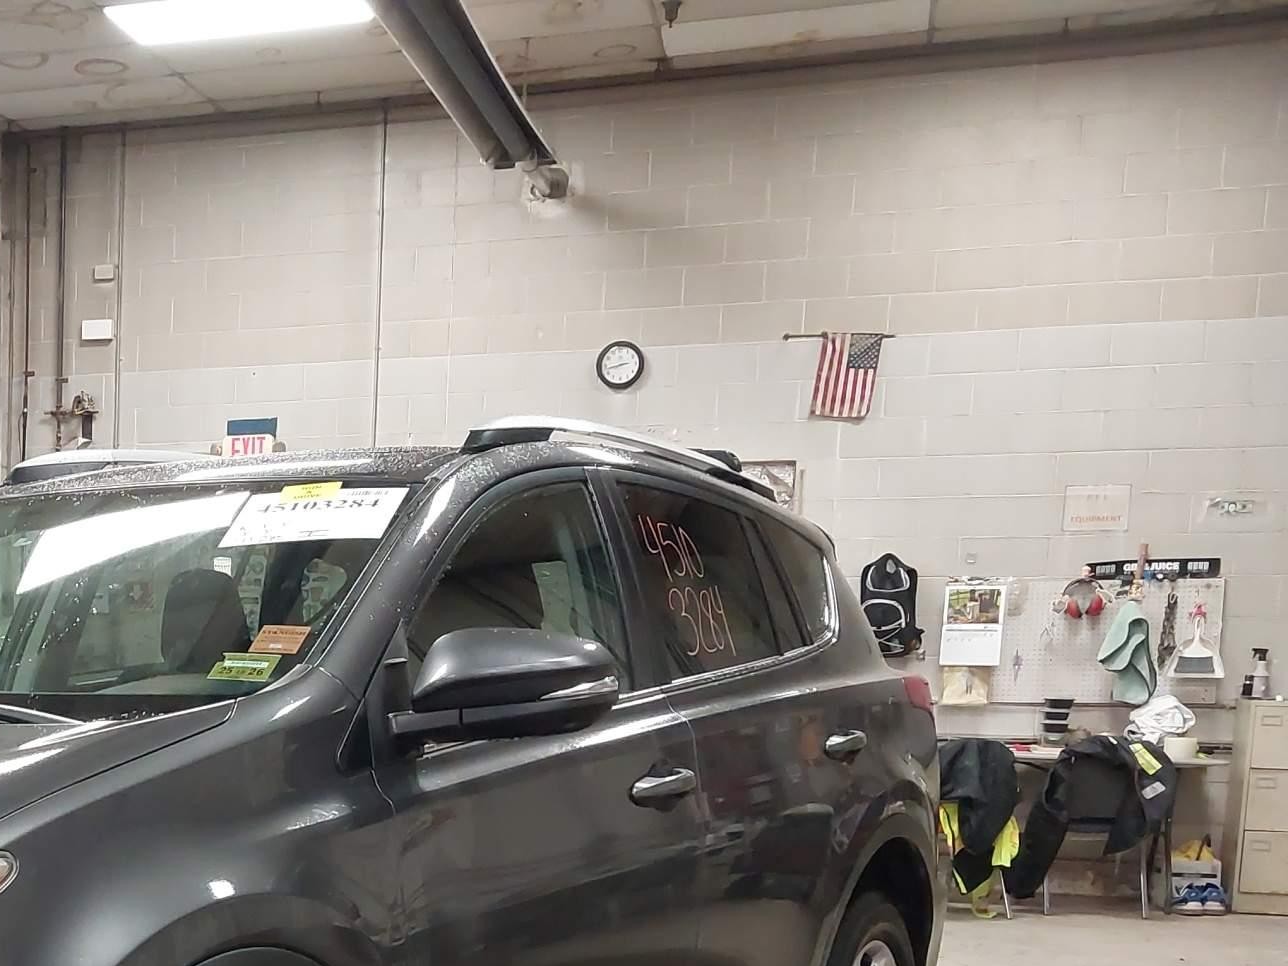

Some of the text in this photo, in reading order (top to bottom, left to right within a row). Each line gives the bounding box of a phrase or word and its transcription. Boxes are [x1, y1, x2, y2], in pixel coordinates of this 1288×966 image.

[231, 436, 266, 457] EXIT
[257, 497, 382, 515] 45103284
[638, 514, 705, 582] 4510
[1150, 561, 1181, 571] JUICE
[668, 585, 737, 657] 3284
